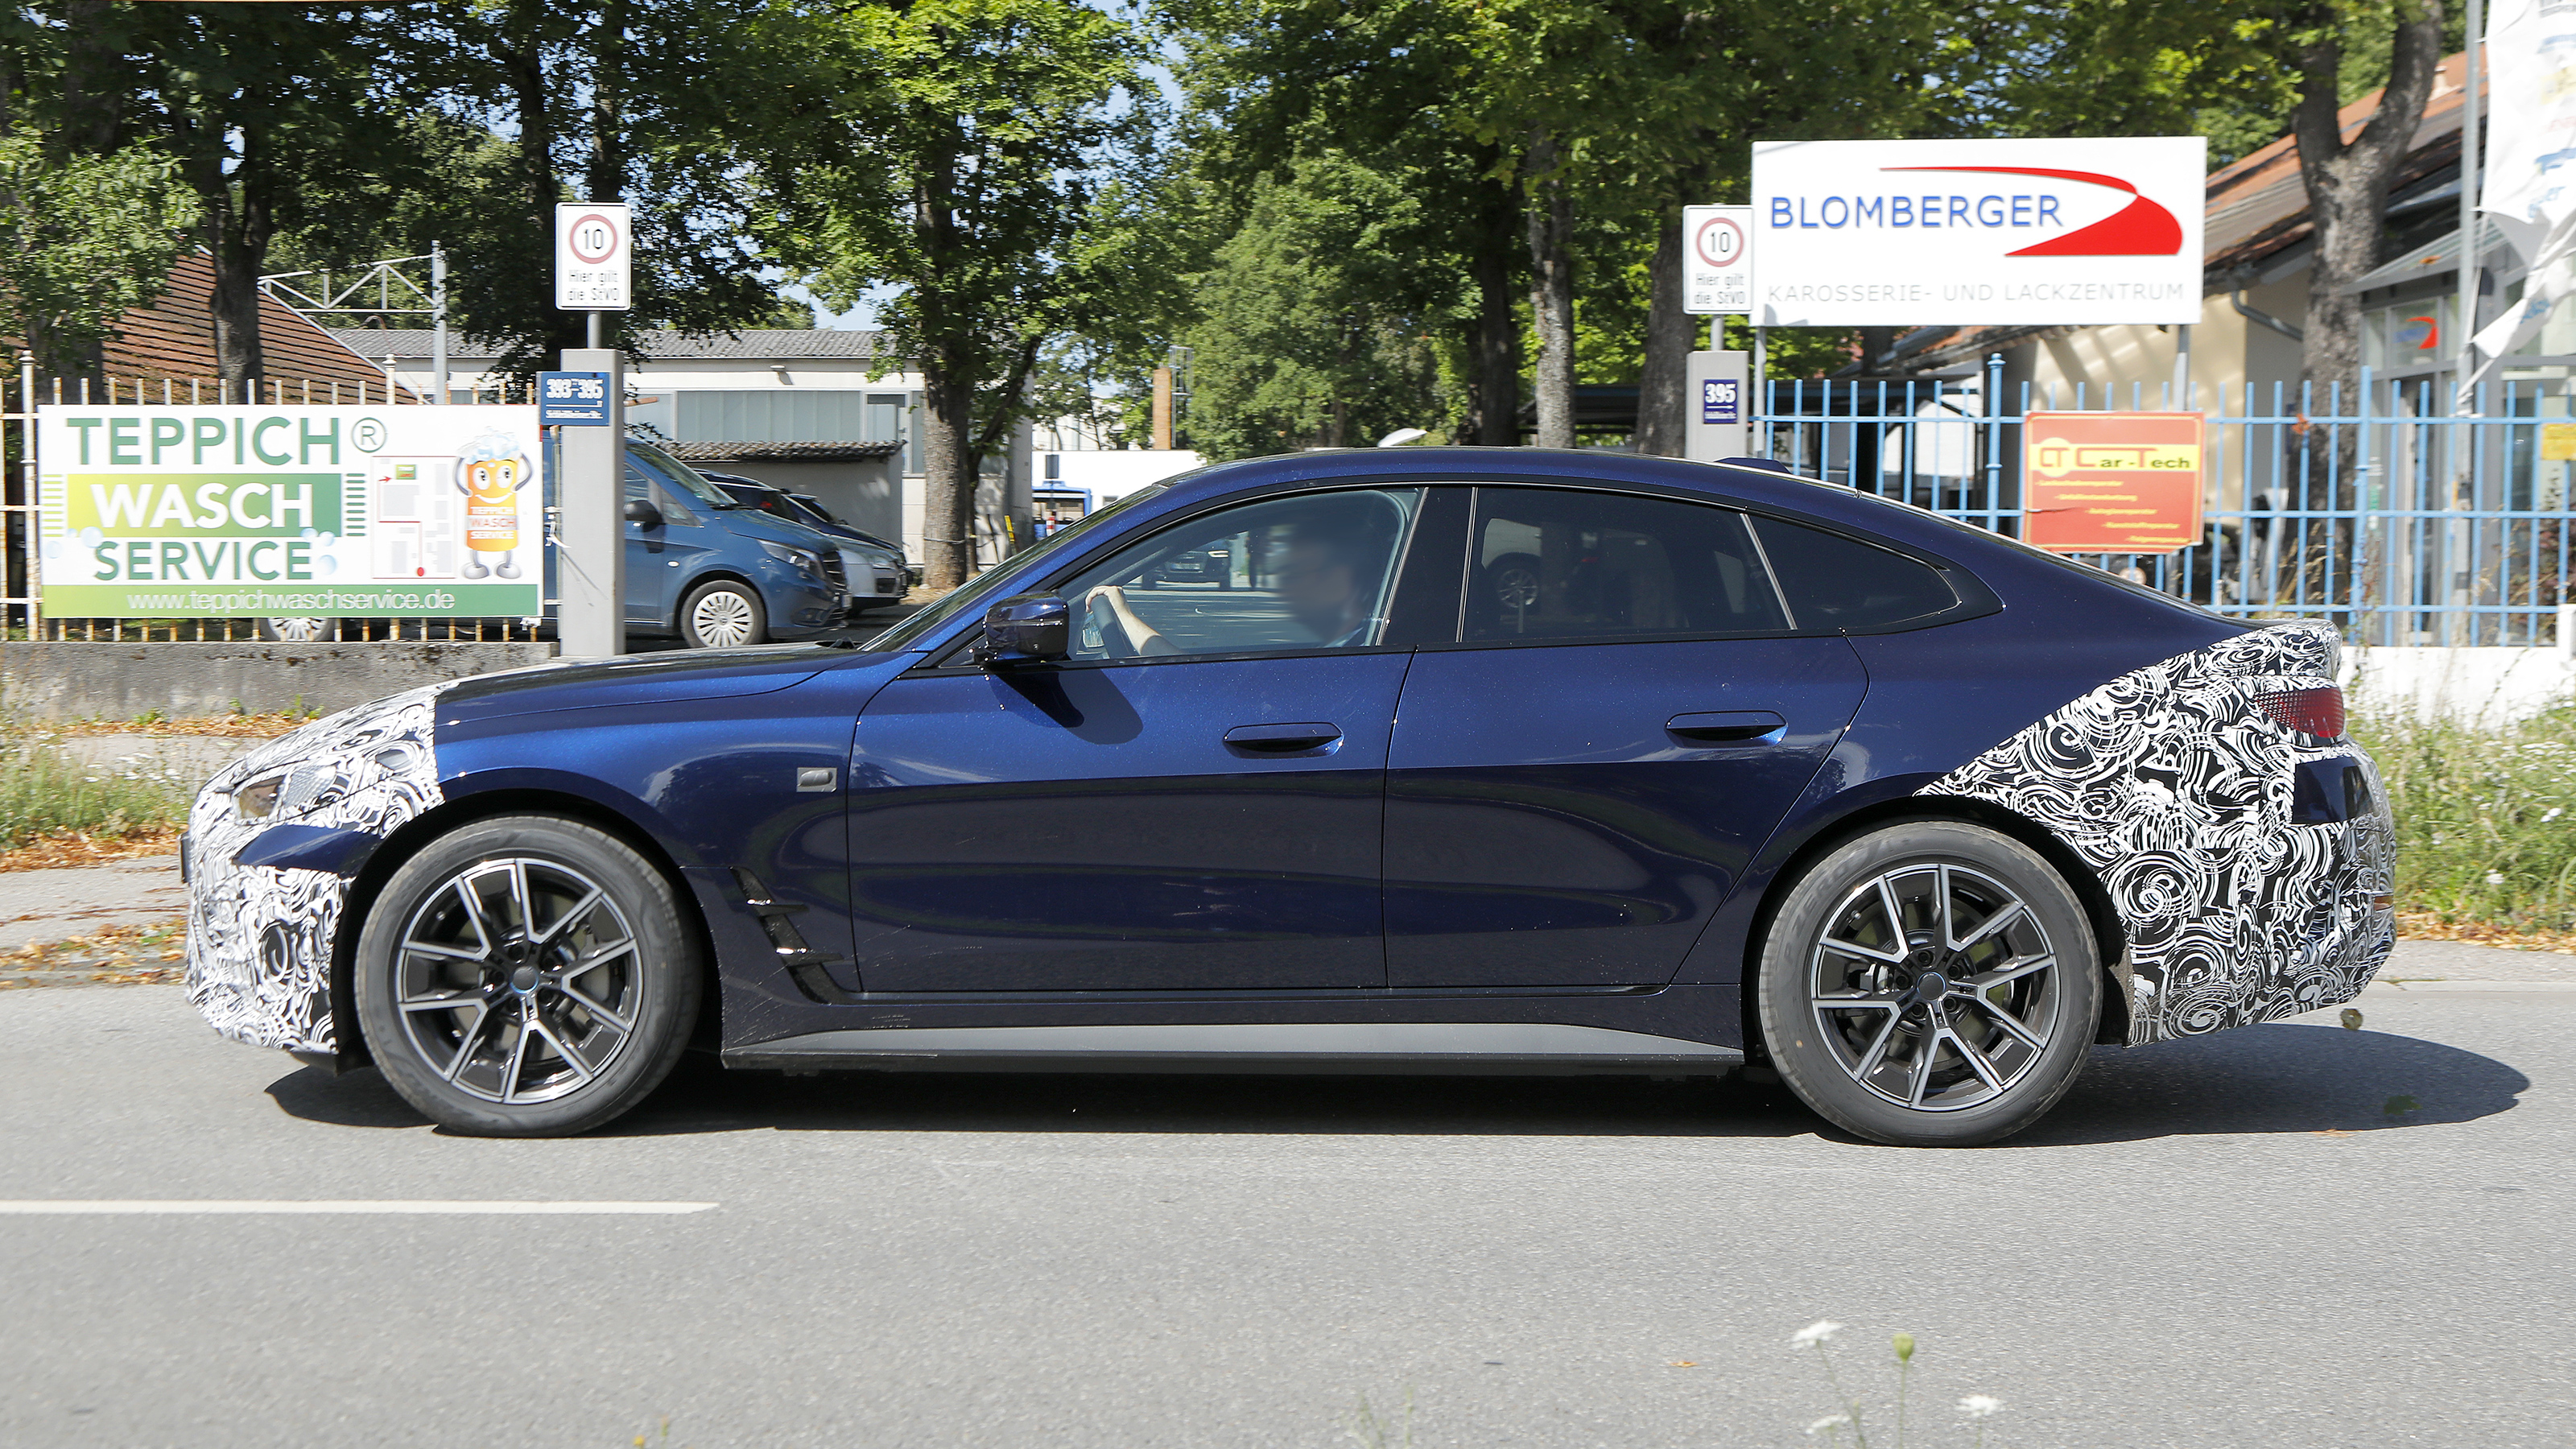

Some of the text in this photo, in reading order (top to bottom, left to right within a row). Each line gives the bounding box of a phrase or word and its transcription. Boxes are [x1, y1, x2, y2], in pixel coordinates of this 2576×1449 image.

[1771, 195, 2063, 229] BLOMBERGER
[583, 228, 605, 250] 10
[1710, 232, 1730, 253] 10
[568, 270, 618, 286] Hier gilt
[1695, 273, 1744, 289] Hier gilt
[567, 287, 621, 301] die StVO
[1694, 291, 1746, 304] die StVO
[1768, 282, 2184, 303] KAROSSERIE- UND LACKZENTRUM
[1705, 383, 1737, 404] 395
[90, 483, 313, 528] WASCH
[470, 506, 514, 515] TEPPICH
[470, 518, 517, 528] WASCH
[470, 531, 514, 539] SERVICE
[94, 540, 313, 581] SERVICE
[128, 588, 456, 611] www.teppichwaschservice.de
